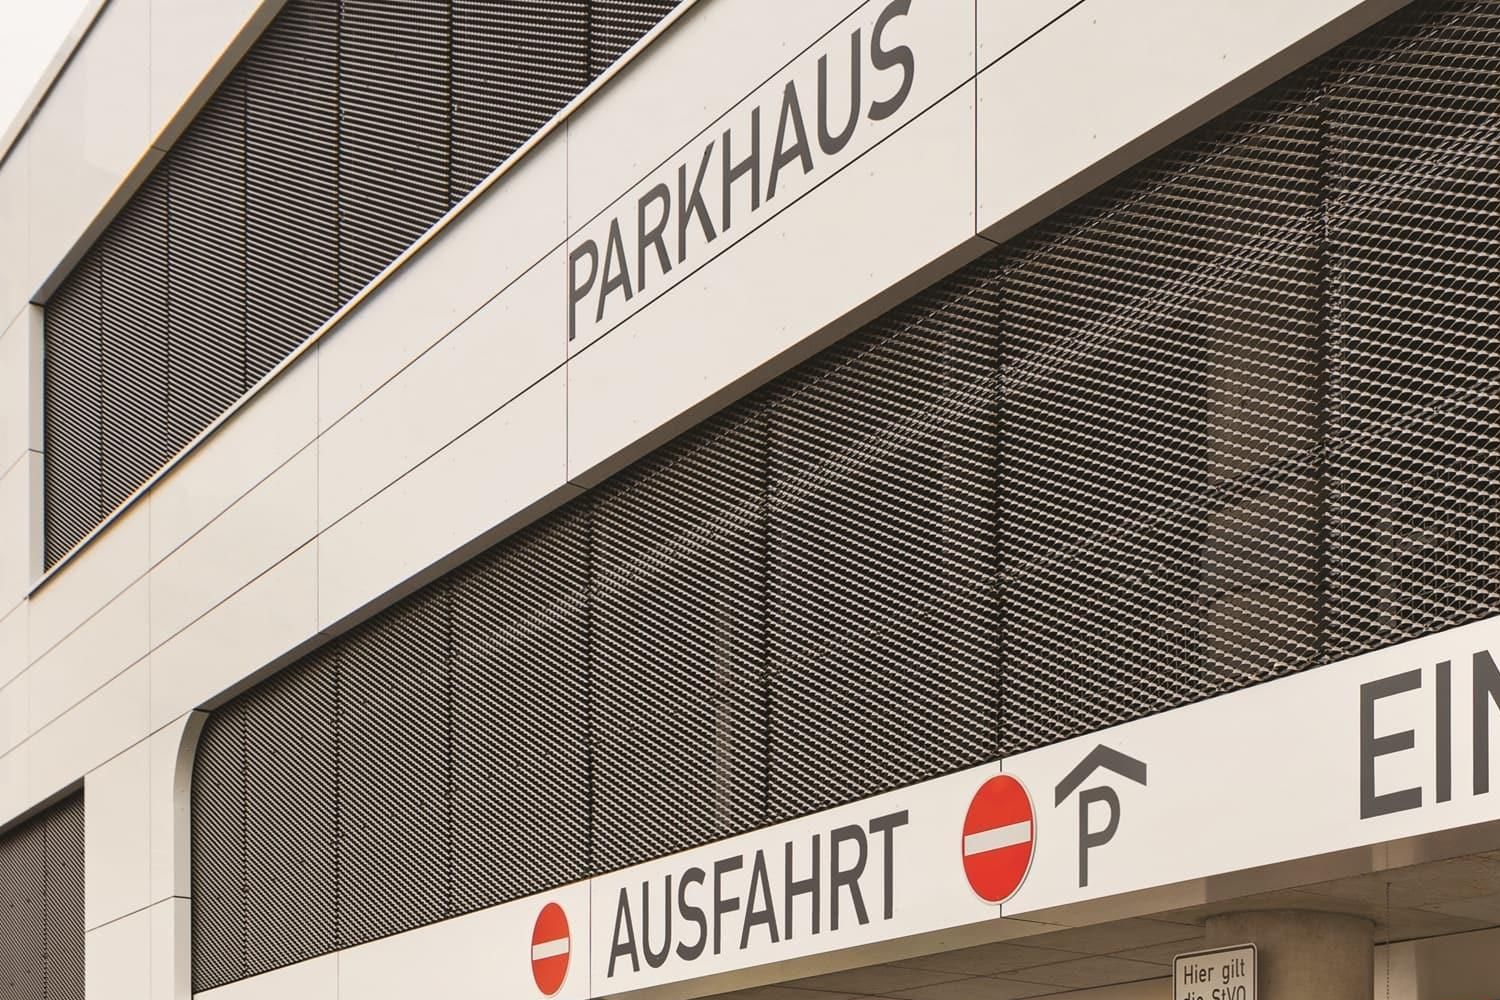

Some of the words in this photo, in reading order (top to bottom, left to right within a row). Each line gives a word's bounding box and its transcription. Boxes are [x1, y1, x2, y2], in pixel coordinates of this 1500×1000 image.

[569, 0, 915, 342] PARKHAUS
[607, 809, 909, 978] AUSFAHRT
[1078, 785, 1121, 888] P
[1184, 964, 1215, 985] Hier
[1222, 958, 1246, 984] gilt
